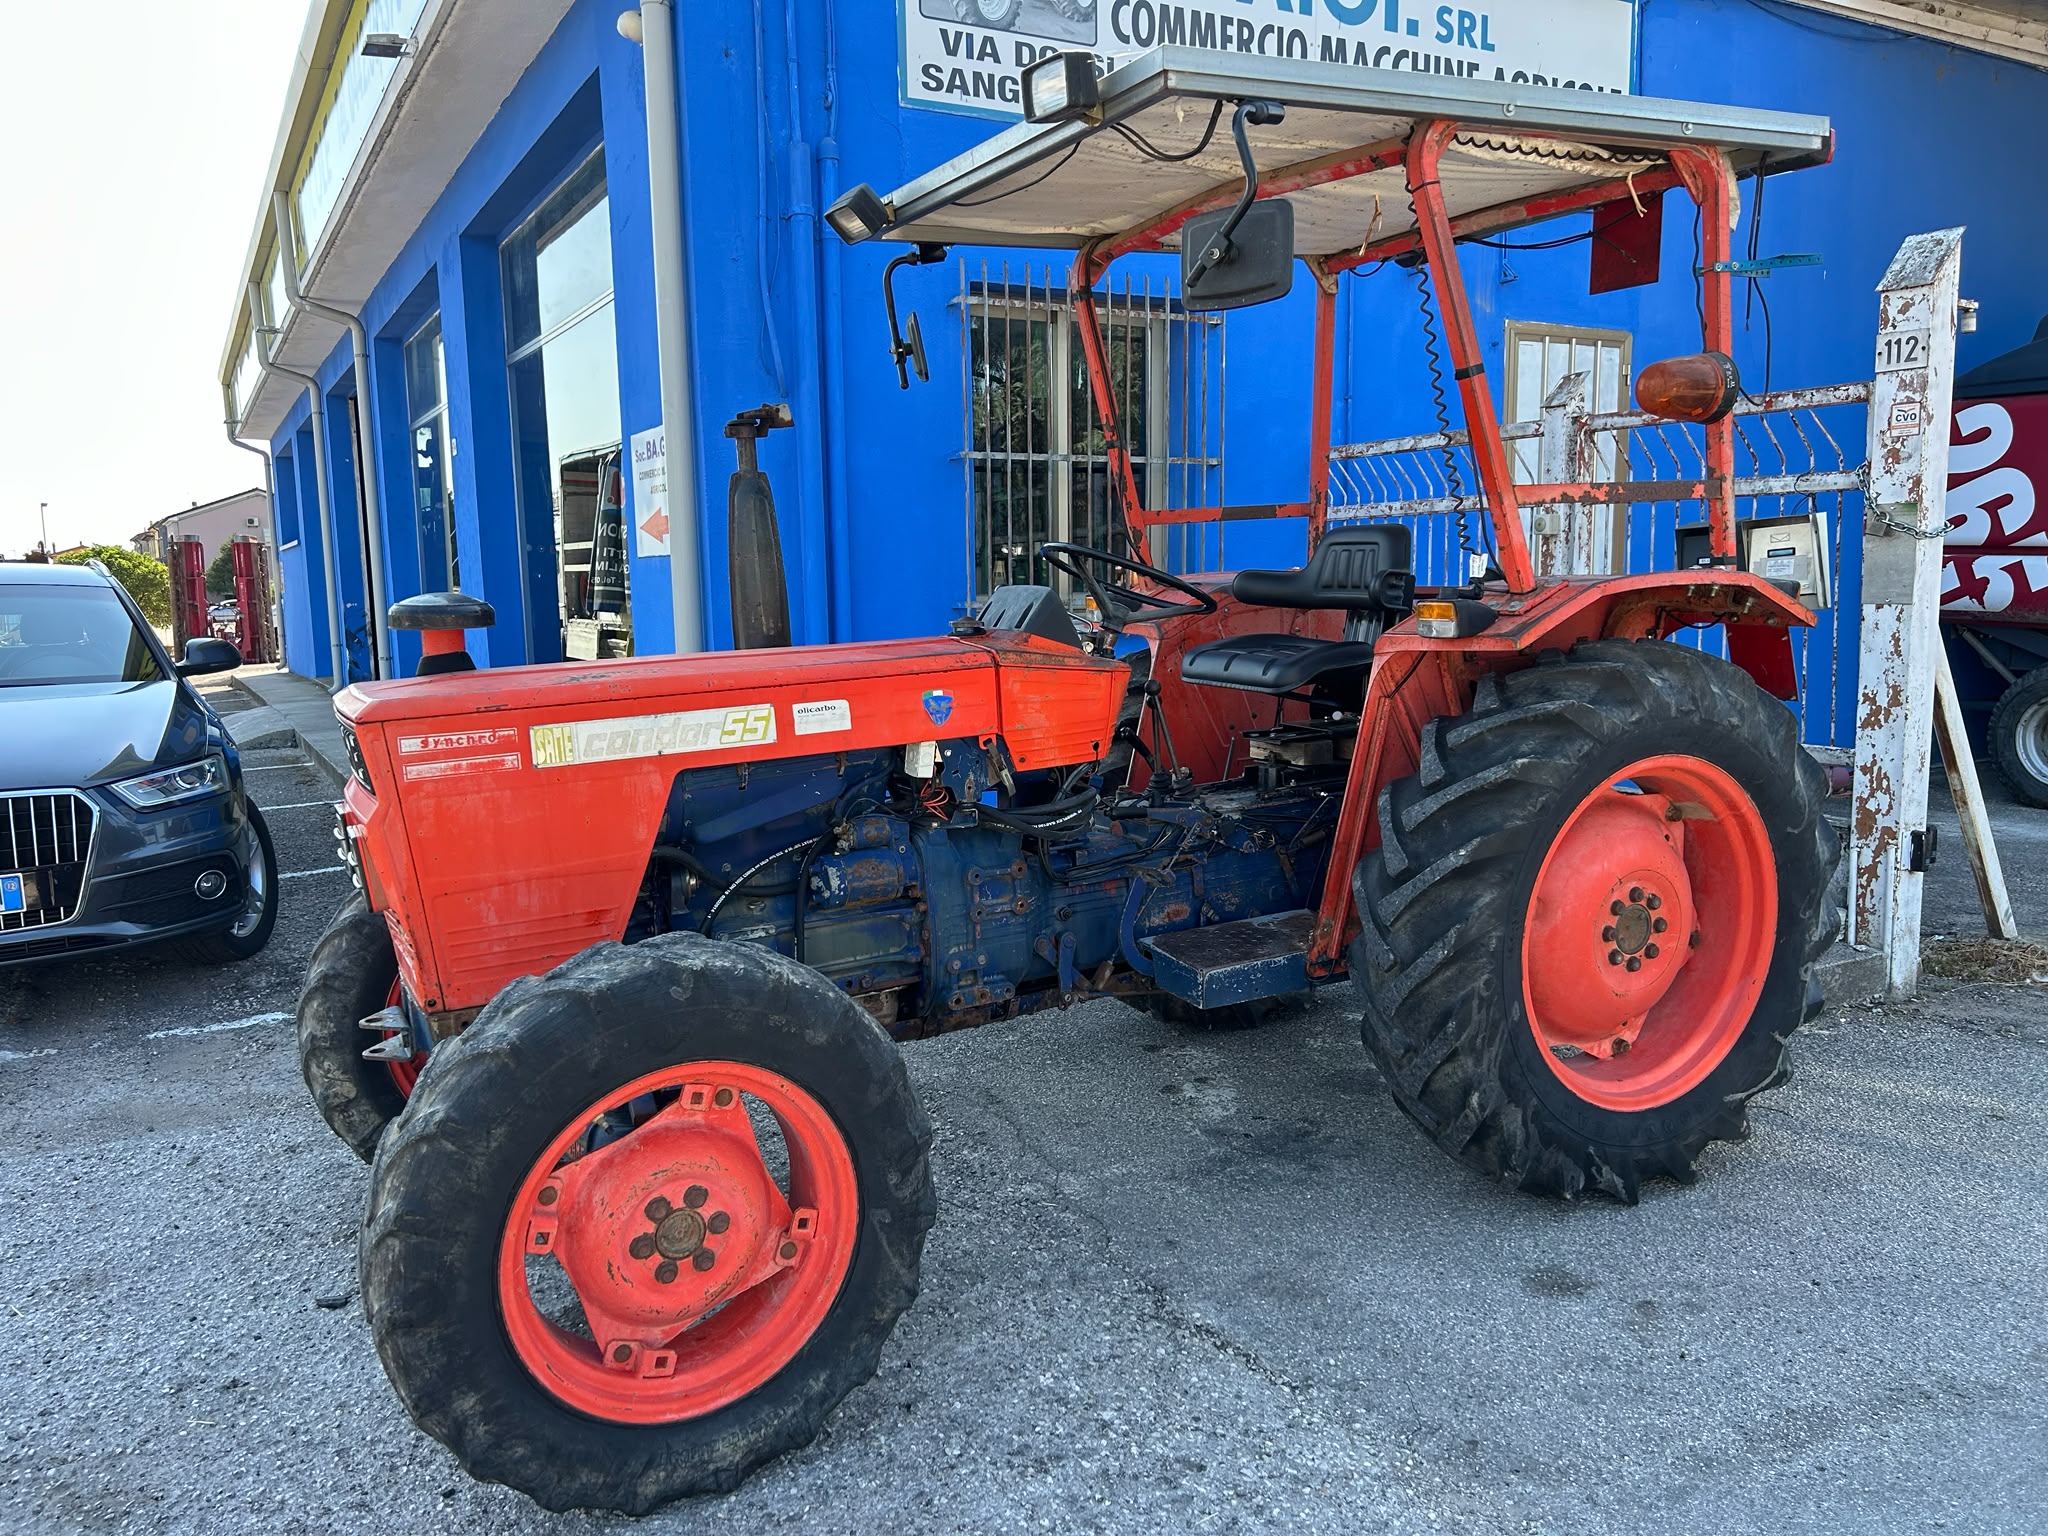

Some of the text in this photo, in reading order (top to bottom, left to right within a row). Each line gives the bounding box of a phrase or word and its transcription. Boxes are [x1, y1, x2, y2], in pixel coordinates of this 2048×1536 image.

[1434, 5, 1496, 52] SRL
[939, 27, 1002, 65] VIA
[1884, 335, 1919, 365] 112
[1895, 412, 1917, 423] CVO
[797, 704, 837, 715] olicarbo
[535, 700, 770, 765] SAME condor 55
